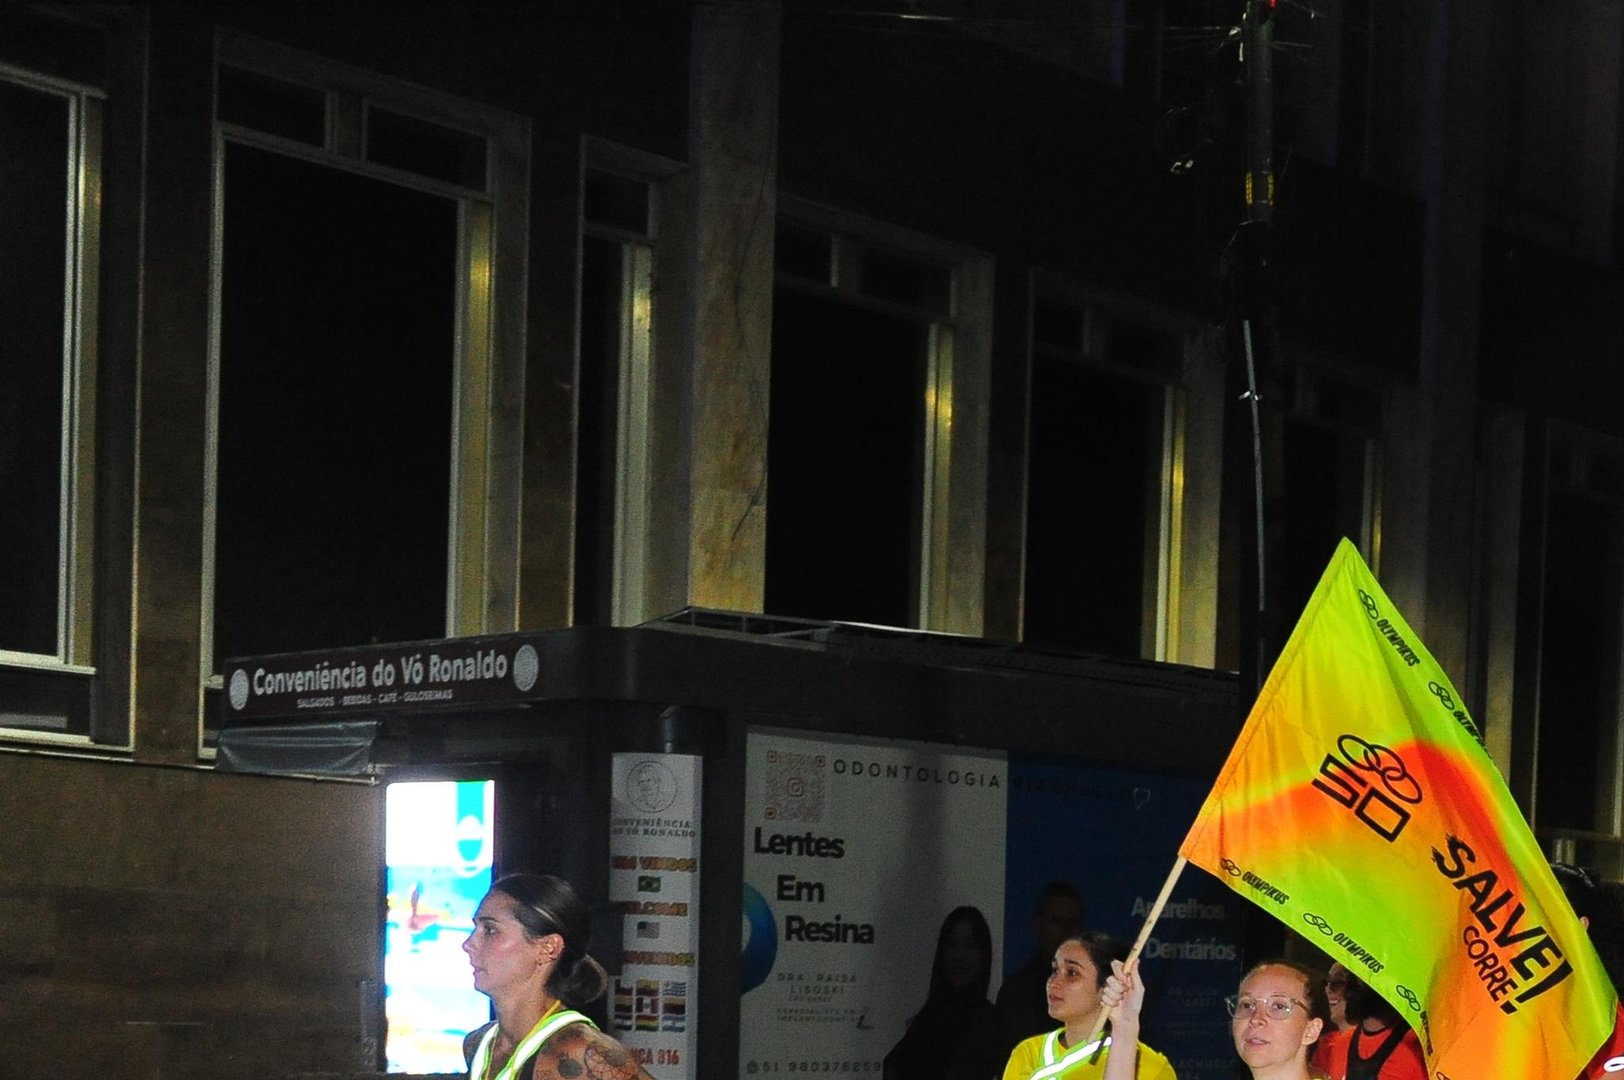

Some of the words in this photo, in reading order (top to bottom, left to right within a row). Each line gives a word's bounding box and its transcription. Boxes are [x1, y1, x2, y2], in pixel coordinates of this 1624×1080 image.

[1377, 619, 1420, 666] OLYMPIKUS
[371, 659, 395, 687] do
[401, 654, 424, 684] Vó
[429, 650, 507, 682] Ronaldo
[833, 759, 1000, 788] ODONTOLOGIA
[754, 826, 845, 859] Lentes
[776, 875, 825, 902] Em
[1242, 871, 1290, 905] OLYMPIKUS
[785, 914, 874, 944] Resina
[1431, 833, 1574, 1015] SALVE!
[1145, 937, 1236, 960] Dentários
[1333, 933, 1385, 974] OLYMPIKUS
[1463, 925, 1519, 1001] CORRE
